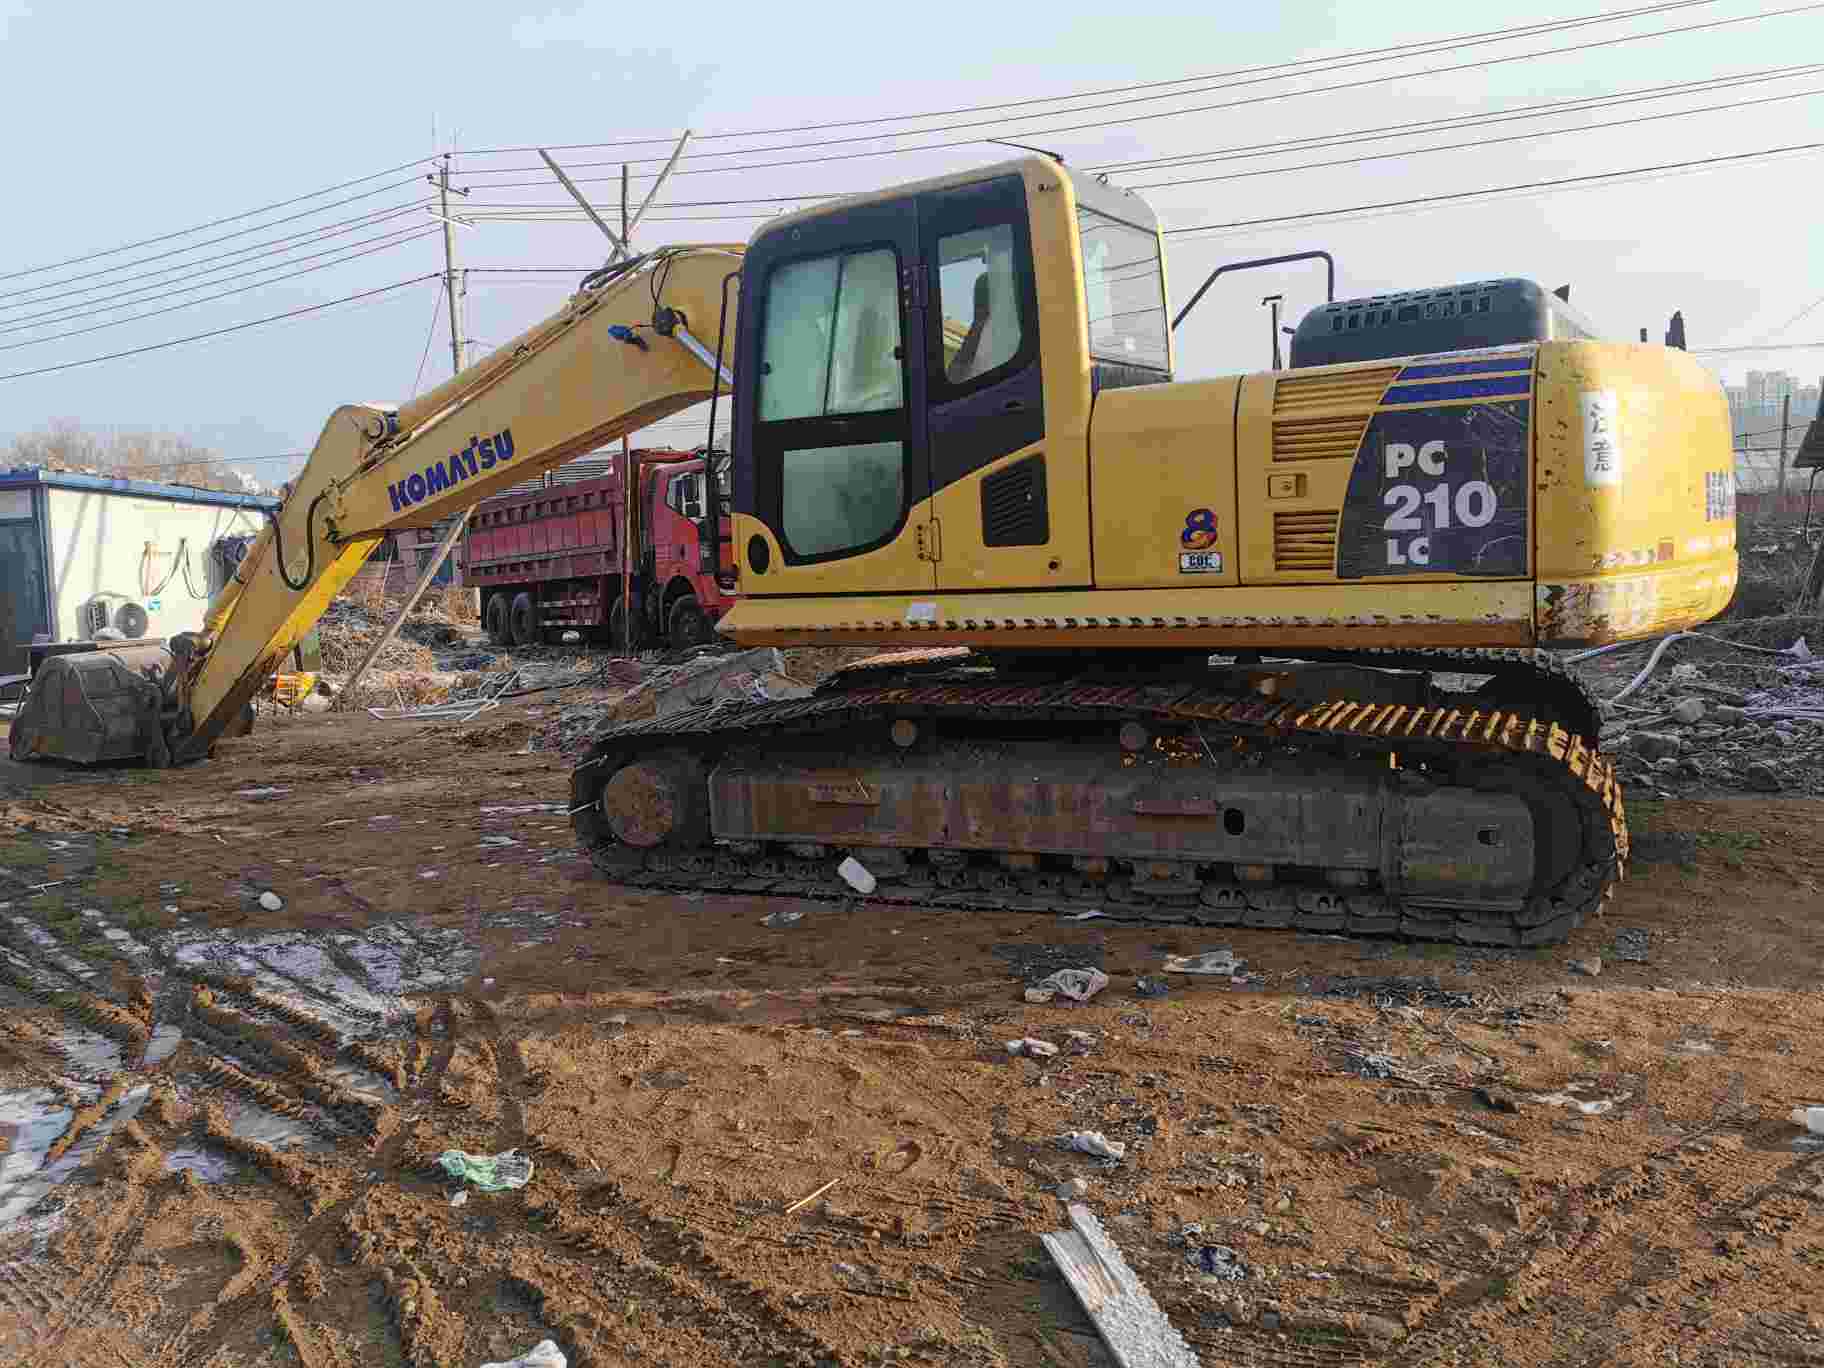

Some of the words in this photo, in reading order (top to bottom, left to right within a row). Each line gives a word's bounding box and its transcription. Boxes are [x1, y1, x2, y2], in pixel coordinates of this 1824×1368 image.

[388, 428, 515, 512] KOMATSU
[1384, 440, 1448, 478] PC
[1383, 480, 1498, 531] 210
[1182, 508, 1217, 549] 8
[1387, 536, 1430, 565] LC
